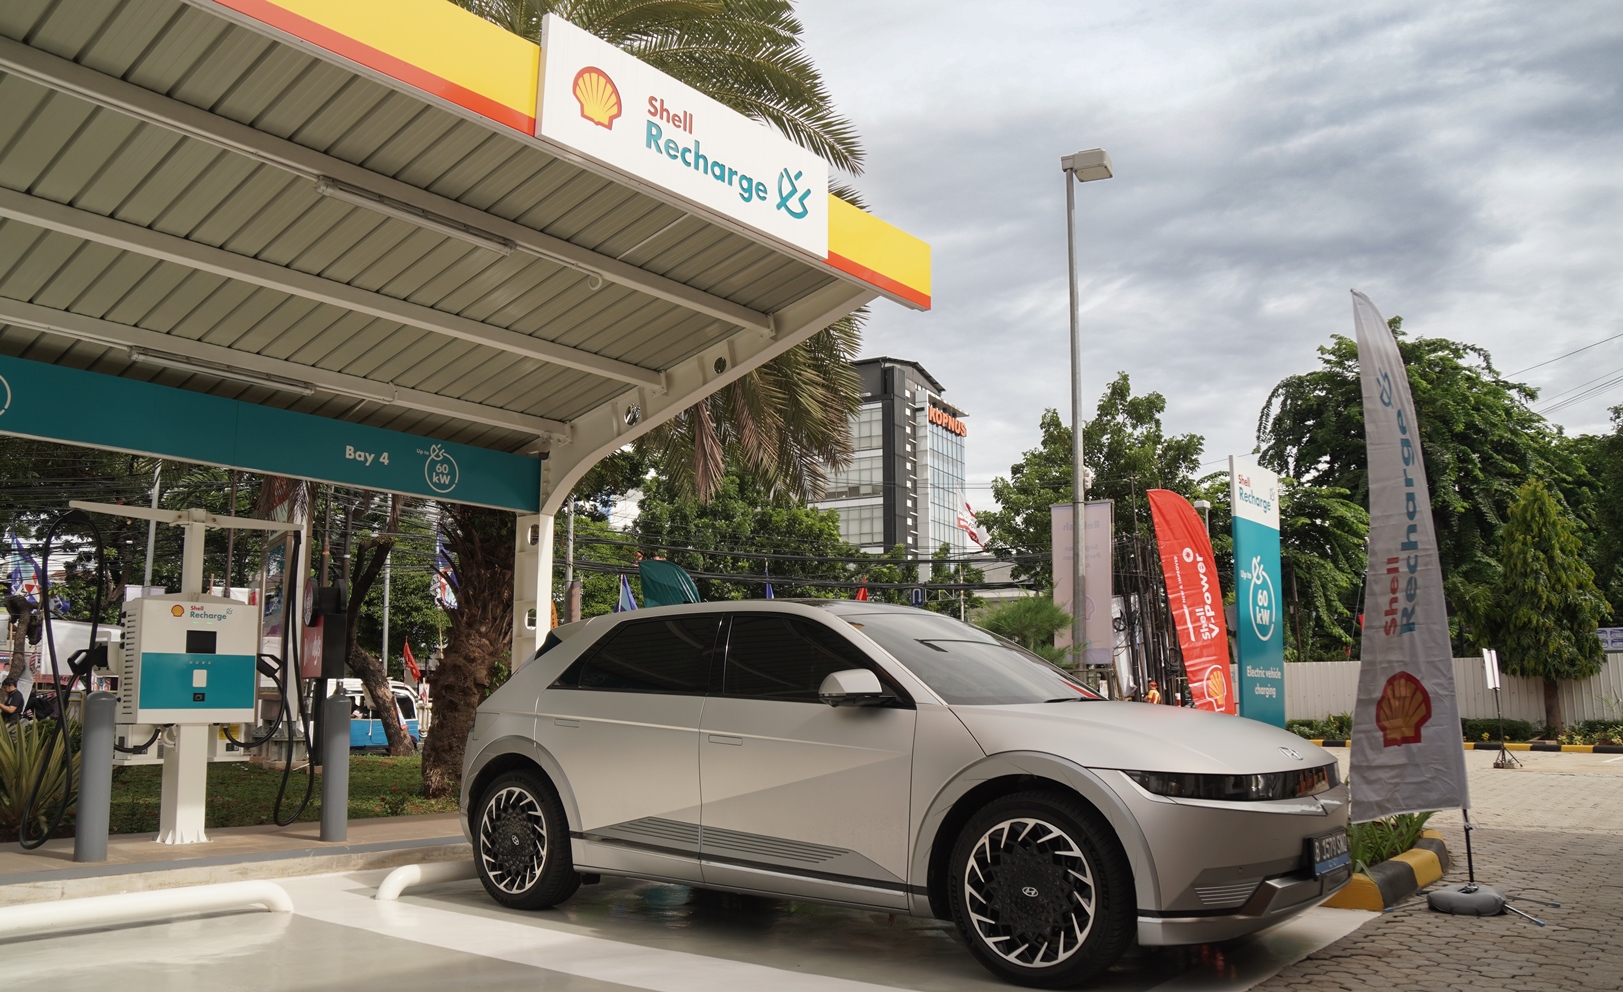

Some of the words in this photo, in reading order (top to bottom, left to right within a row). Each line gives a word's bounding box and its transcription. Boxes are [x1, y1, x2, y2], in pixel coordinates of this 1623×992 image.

[647, 95, 694, 135] Shell
[645, 119, 769, 204] Recharge
[928, 405, 967, 437] KOPNUS
[345, 445, 375, 466] Bay
[379, 452, 389, 466] 4
[432, 472, 451, 485] kW
[435, 463, 449, 474] 60
[1238, 474, 1251, 488] Shell
[1238, 486, 1271, 514] Recharge
[1396, 408, 1419, 635] Recharge
[1240, 569, 1247, 580] Up
[1247, 571, 1252, 579] to
[1195, 553, 1220, 639] V-Power
[1257, 589, 1268, 607] 60
[1384, 556, 1400, 637] Shell
[190, 611, 227, 621] Recharge
[1195, 607, 1211, 640] Shell
[1256, 606, 1270, 626] kW
[1247, 665, 1265, 678] Electric
[1265, 667, 1281, 679] vehicle
[1255, 683, 1276, 699] charging
